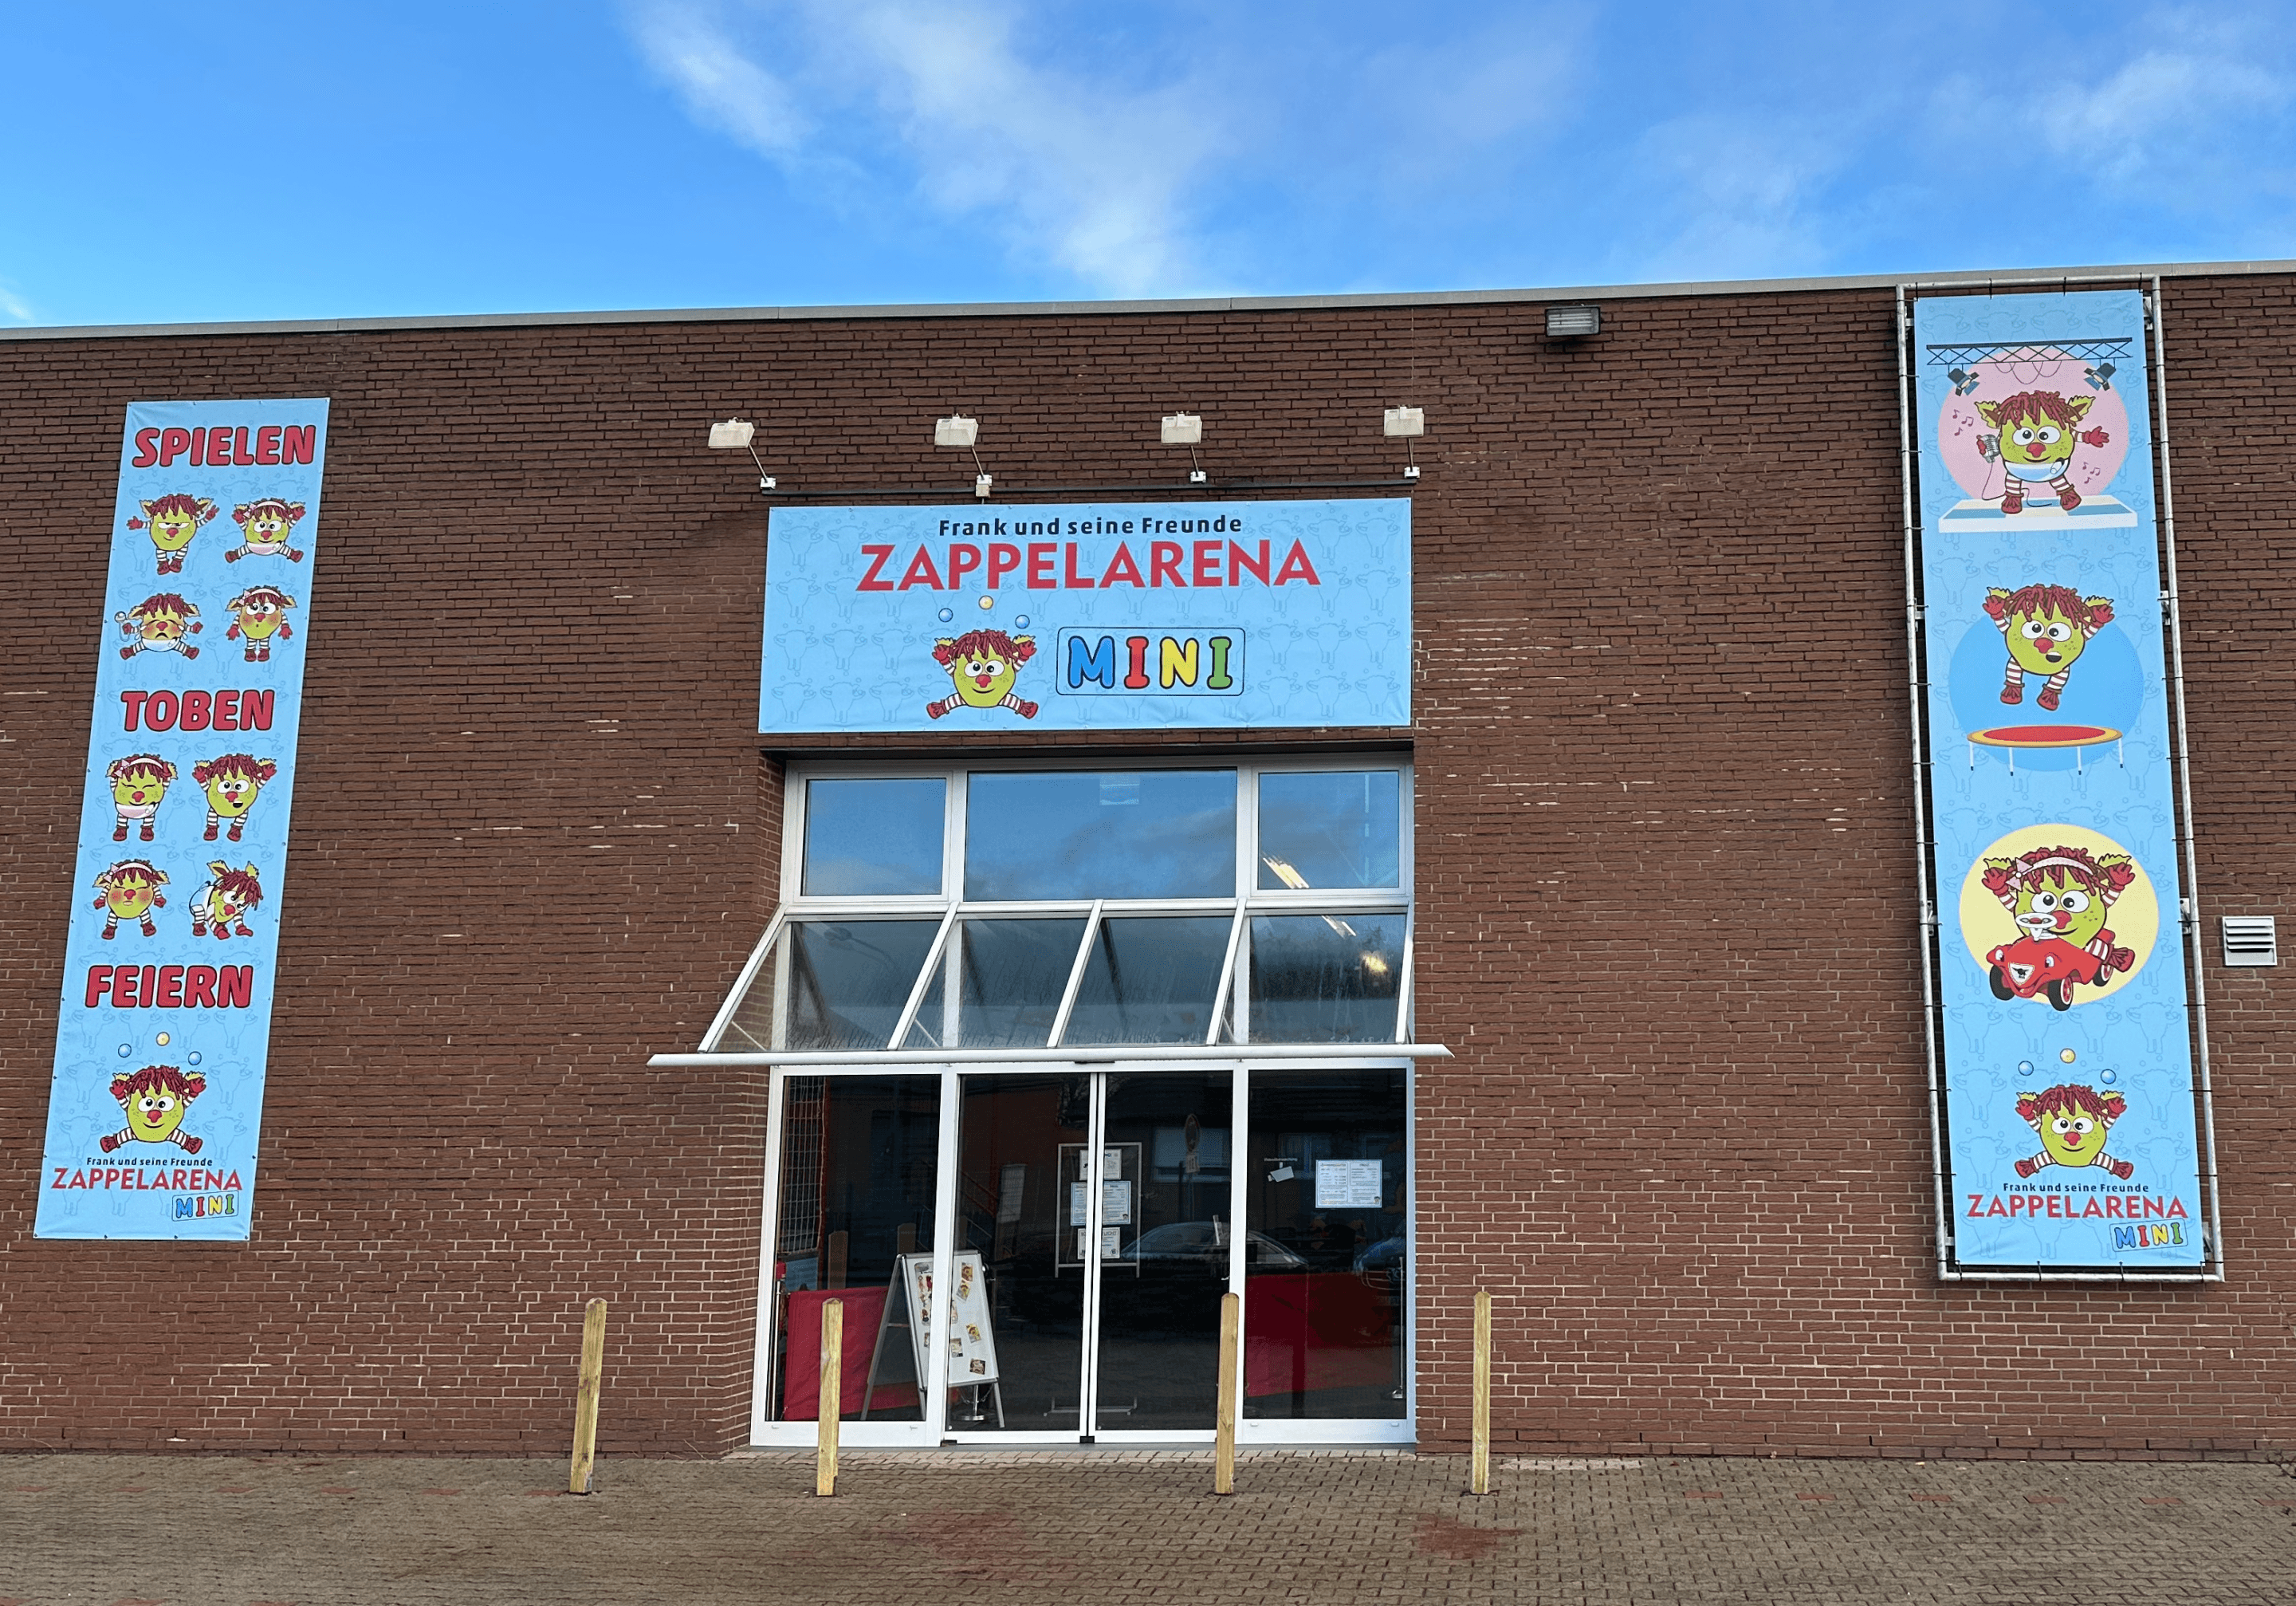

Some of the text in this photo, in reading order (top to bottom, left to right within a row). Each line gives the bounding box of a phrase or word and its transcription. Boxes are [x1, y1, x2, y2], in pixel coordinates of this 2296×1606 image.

[132, 425, 316, 467] SPIELEN
[939, 515, 1241, 536] Frank und seine Freunde
[855, 538, 1320, 591] ZAPPELARENA
[1067, 636, 1233, 690] MINI
[120, 690, 274, 732] TOBEN
[85, 965, 254, 1008] FEIERN
[86, 1157, 213, 1167] Frank und seine Freunde
[51, 1168, 242, 1191] ZAPPELARENA
[2003, 1183, 2149, 1192] Frank und seine Freunde
[175, 1194, 235, 1218] MINI
[1968, 1195, 2188, 1218] ZAPPELARENA
[2114, 1222, 2184, 1249] MINI
